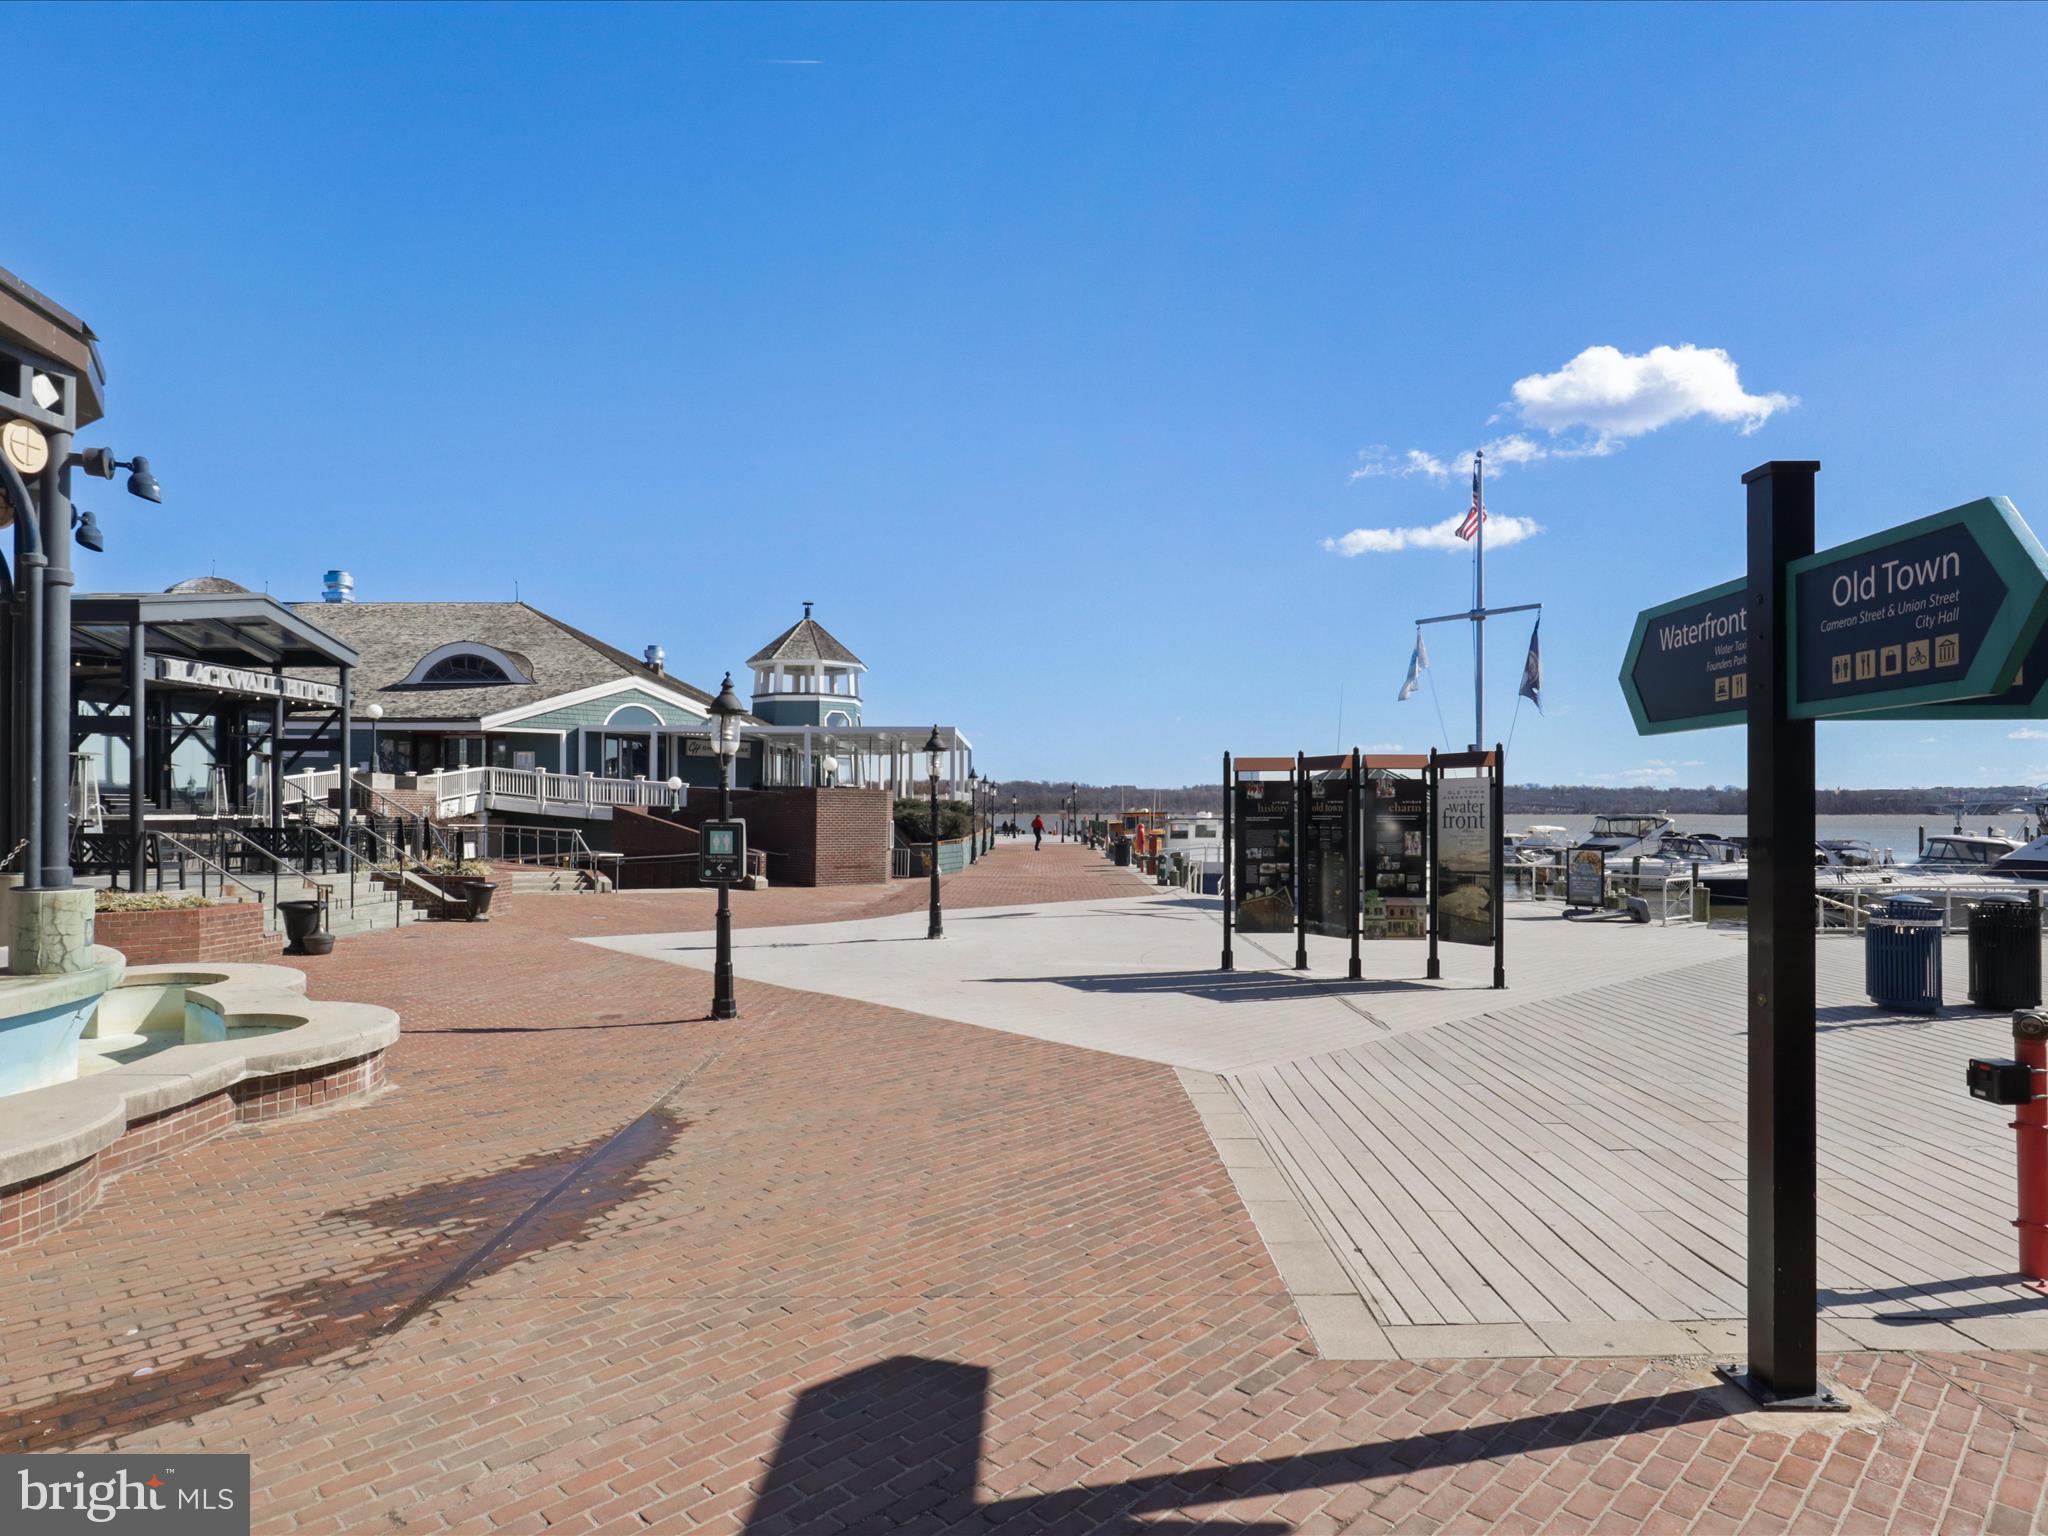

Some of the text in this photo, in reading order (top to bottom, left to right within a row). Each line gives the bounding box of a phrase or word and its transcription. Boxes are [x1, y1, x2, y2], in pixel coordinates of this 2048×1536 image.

[1832, 551, 1960, 607] Old Town
[1820, 589, 1960, 633] Cameron Street & Union Street
[1915, 606, 1960, 630] City Hall
[1659, 607, 1747, 651] Waterfront
[1714, 639, 1747, 656] Water Taxi
[1706, 655, 1747, 673] Founders Park
[163, 658, 336, 704] BLACKWALL HITCH
[1257, 802, 1289, 816] history
[1312, 801, 1344, 812] old town
[1388, 802, 1421, 812] charm
[1449, 799, 1485, 814] water
[1442, 807, 1486, 829] front
